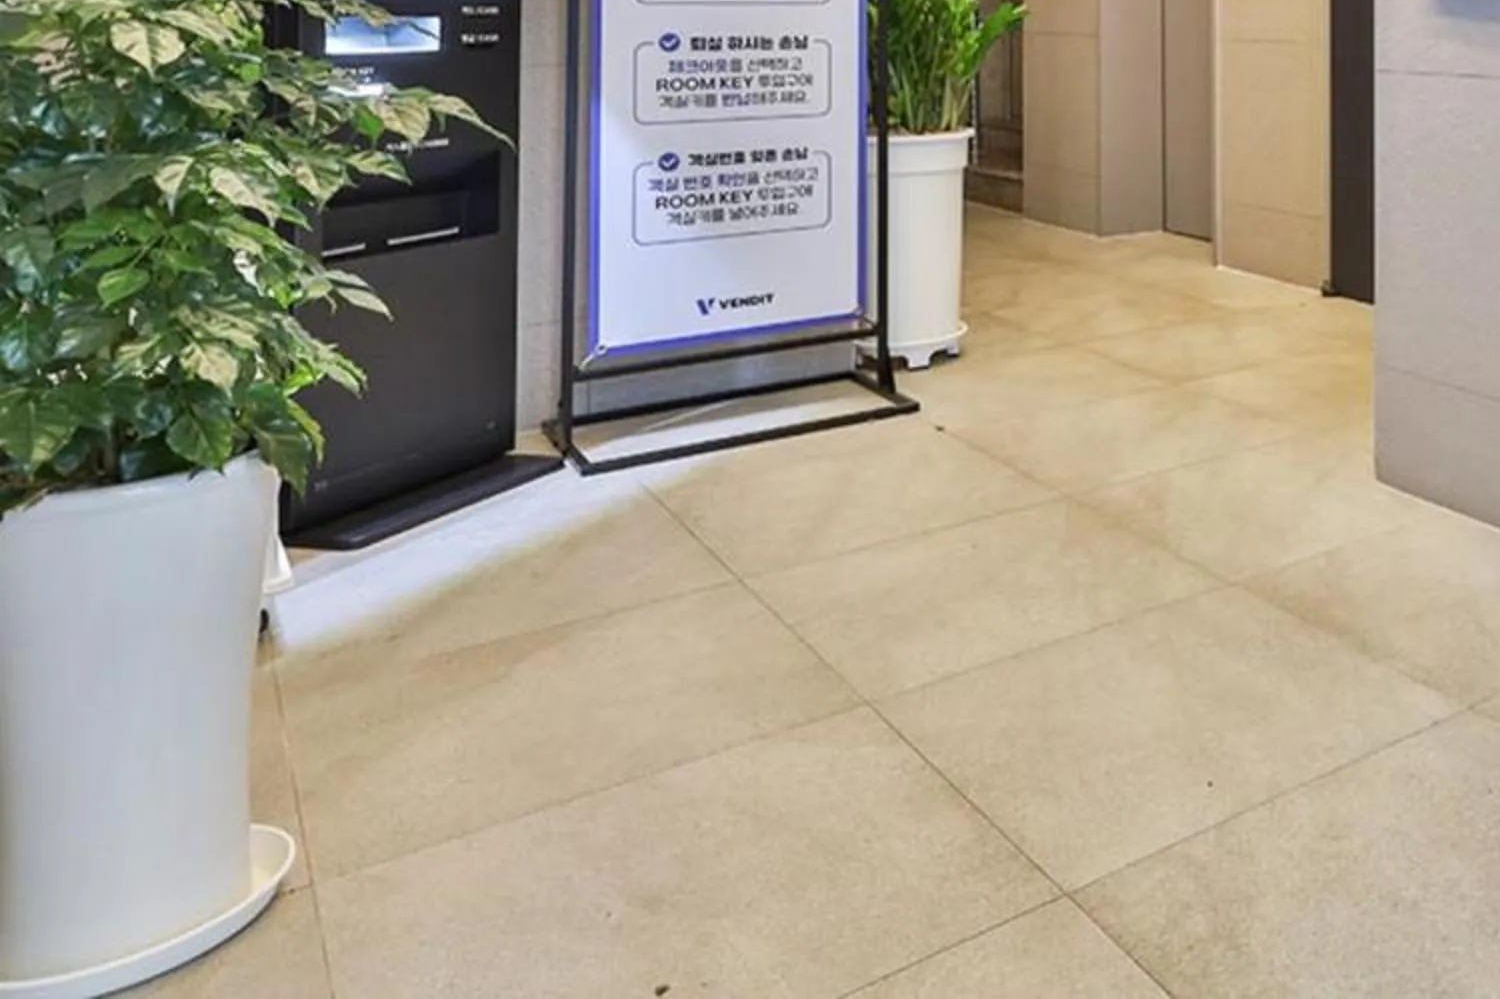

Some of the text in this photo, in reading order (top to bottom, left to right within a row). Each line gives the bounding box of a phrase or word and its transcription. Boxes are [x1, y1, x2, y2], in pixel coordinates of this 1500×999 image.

[727, 36, 774, 51] 하시는
[778, 35, 809, 50] 손님
[656, 77, 716, 92] ROOM
[719, 76, 754, 89] KEY
[781, 147, 809, 162] 손님
[655, 192, 716, 210] ROOM
[719, 190, 754, 205] KEY
[719, 294, 775, 310] VENDIT
